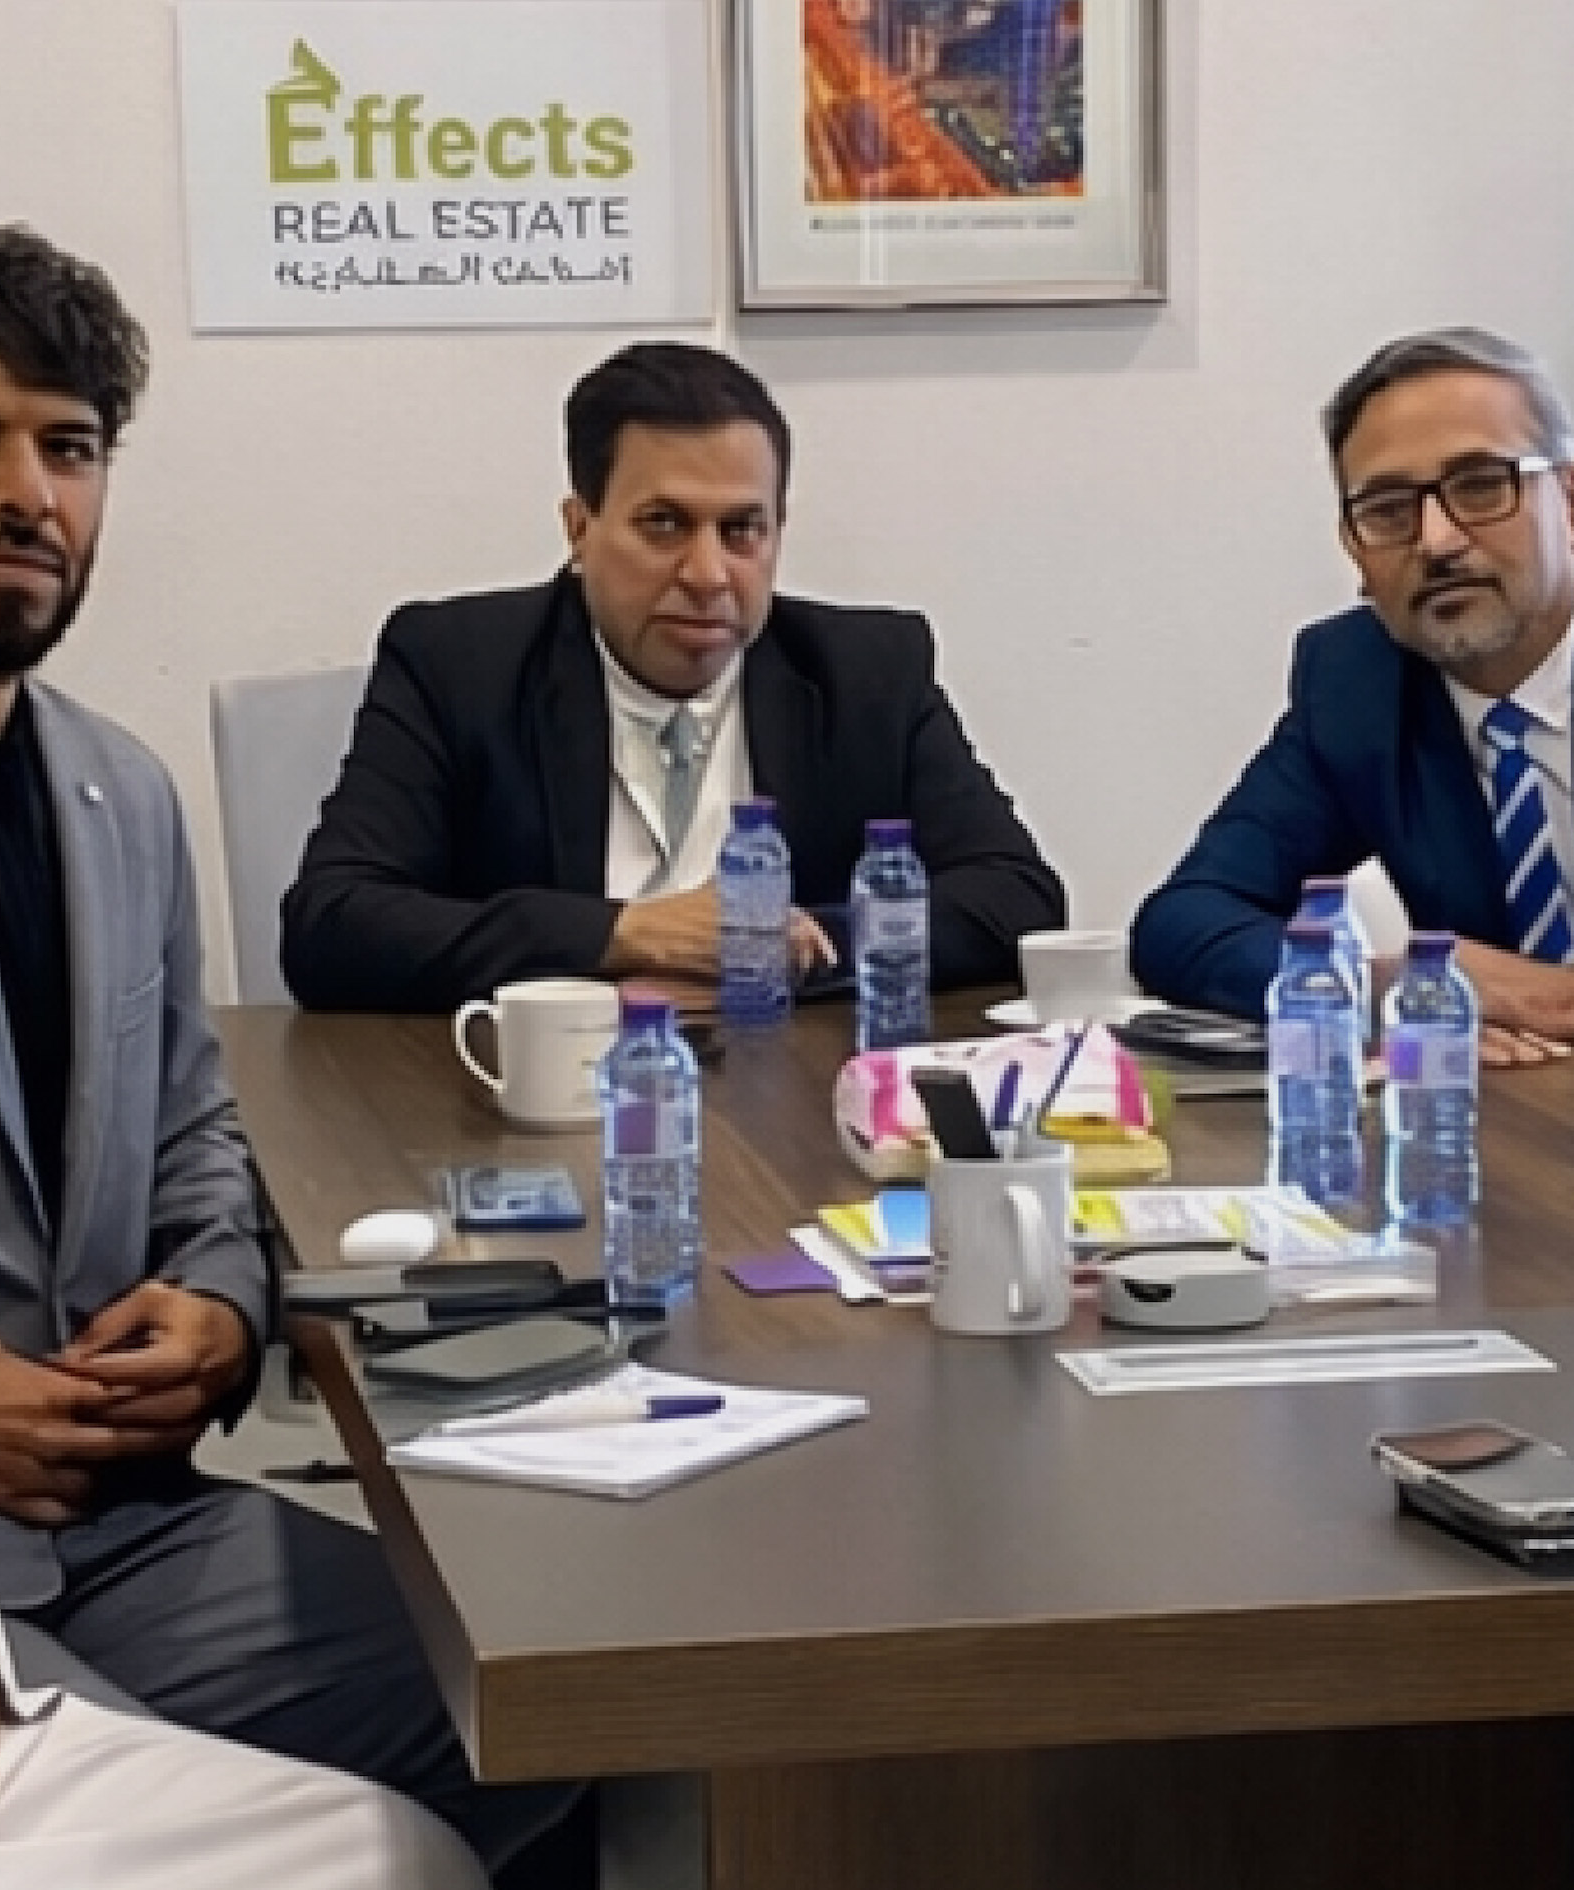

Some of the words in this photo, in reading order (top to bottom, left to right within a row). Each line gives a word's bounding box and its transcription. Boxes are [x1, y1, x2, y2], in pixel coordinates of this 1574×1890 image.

[266, 84, 634, 183] Effects
[274, 200, 416, 242] REAL
[432, 197, 630, 242] ESTATE
